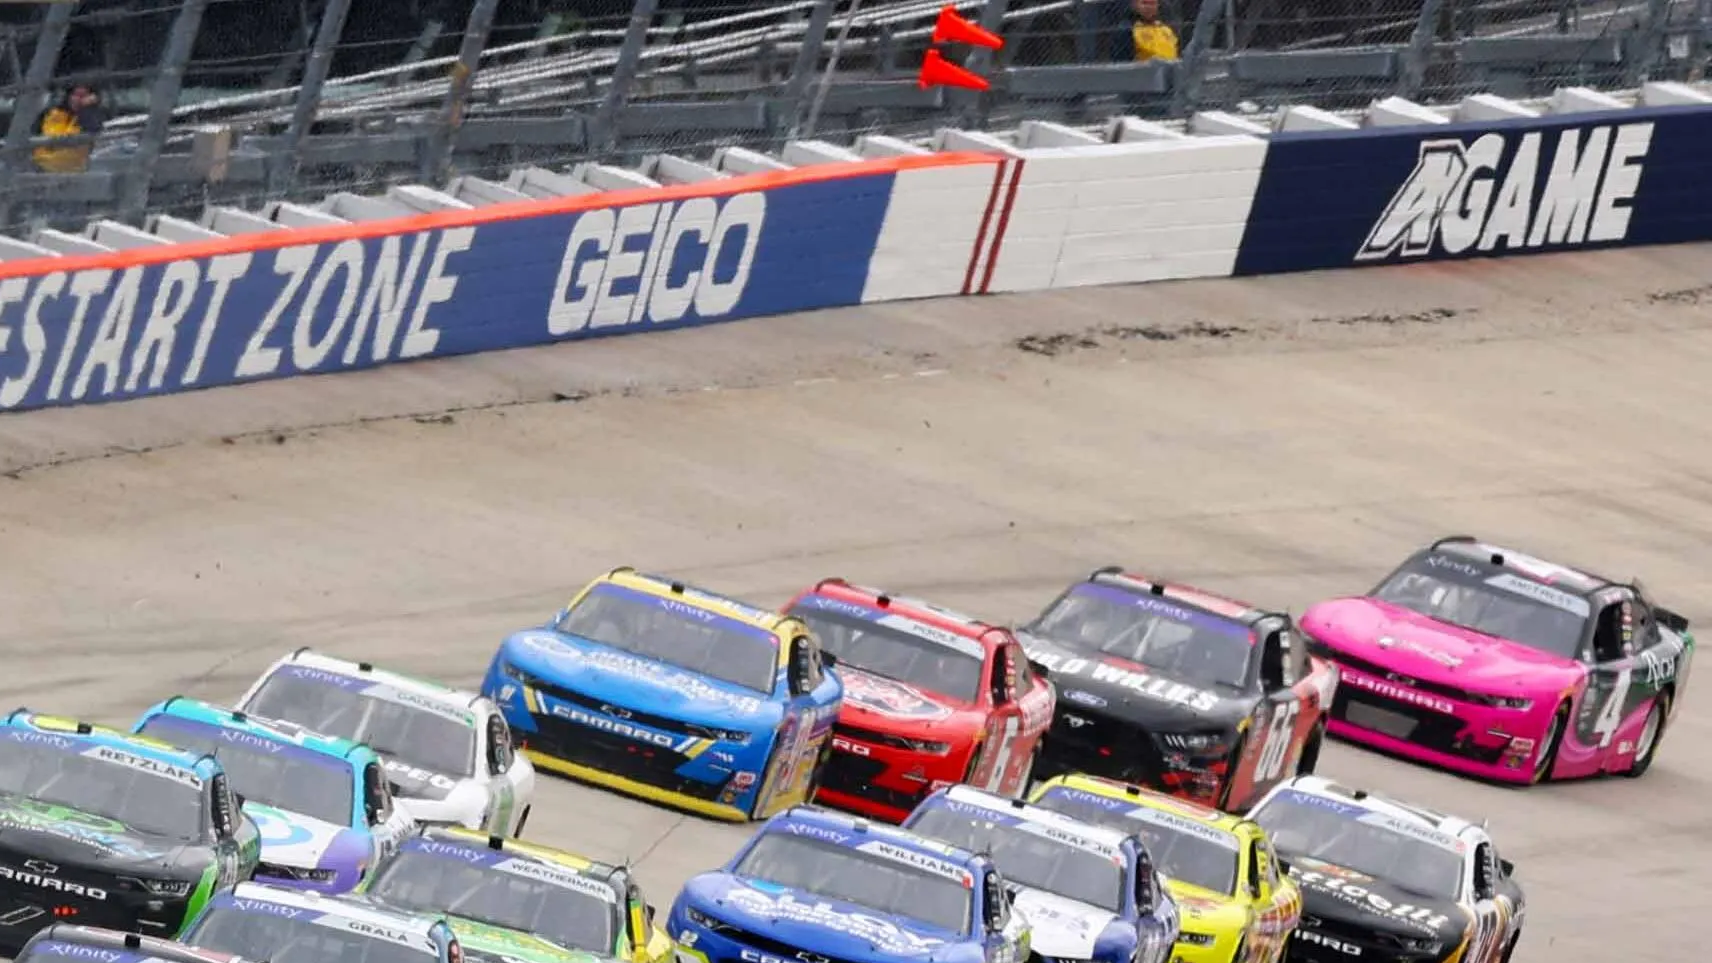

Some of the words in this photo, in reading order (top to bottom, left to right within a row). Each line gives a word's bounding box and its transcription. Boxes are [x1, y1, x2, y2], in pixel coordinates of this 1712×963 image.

[547, 190, 765, 335] GEICO
[234, 226, 475, 378] ZONE
[1593, 669, 1631, 747] 4
[553, 704, 674, 747] CAMARO
[785, 822, 853, 845] xfinity
[417, 840, 489, 862] xfinity
[877, 844, 965, 878] WILLIAMS
[511, 861, 607, 896] WEATHERMAN
[232, 896, 304, 919] xfinity
[349, 920, 409, 943] GRALA
[48, 942, 122, 963] xfinity
